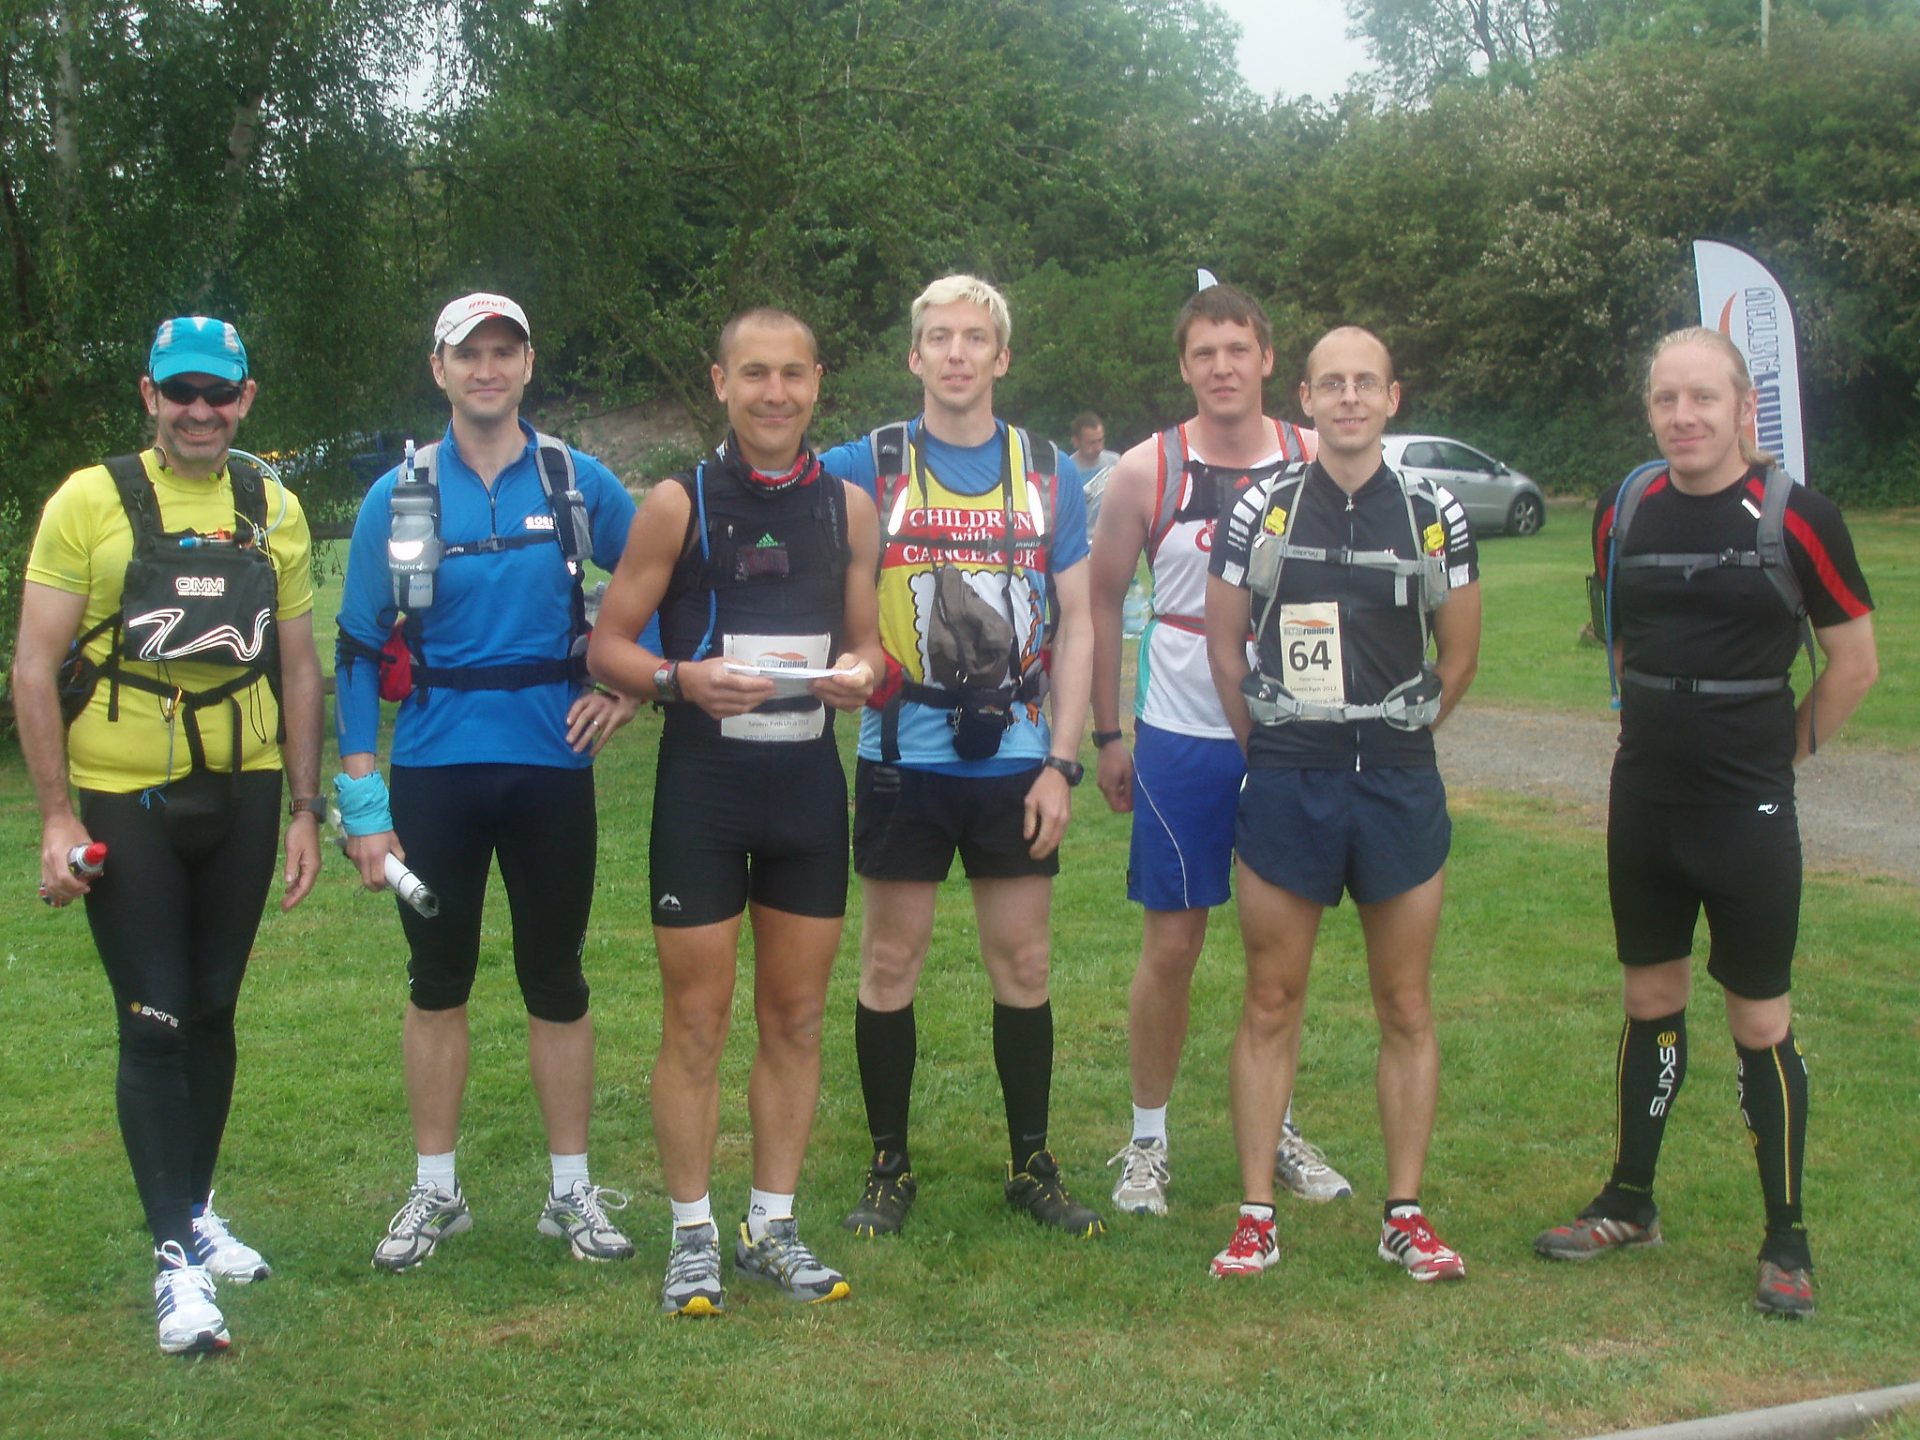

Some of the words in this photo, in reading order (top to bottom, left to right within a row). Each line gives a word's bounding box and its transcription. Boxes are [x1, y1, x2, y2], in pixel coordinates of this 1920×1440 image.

[909, 509, 1033, 531] CHILDRN
[951, 527, 993, 542] with
[1289, 640, 1332, 672] 64
